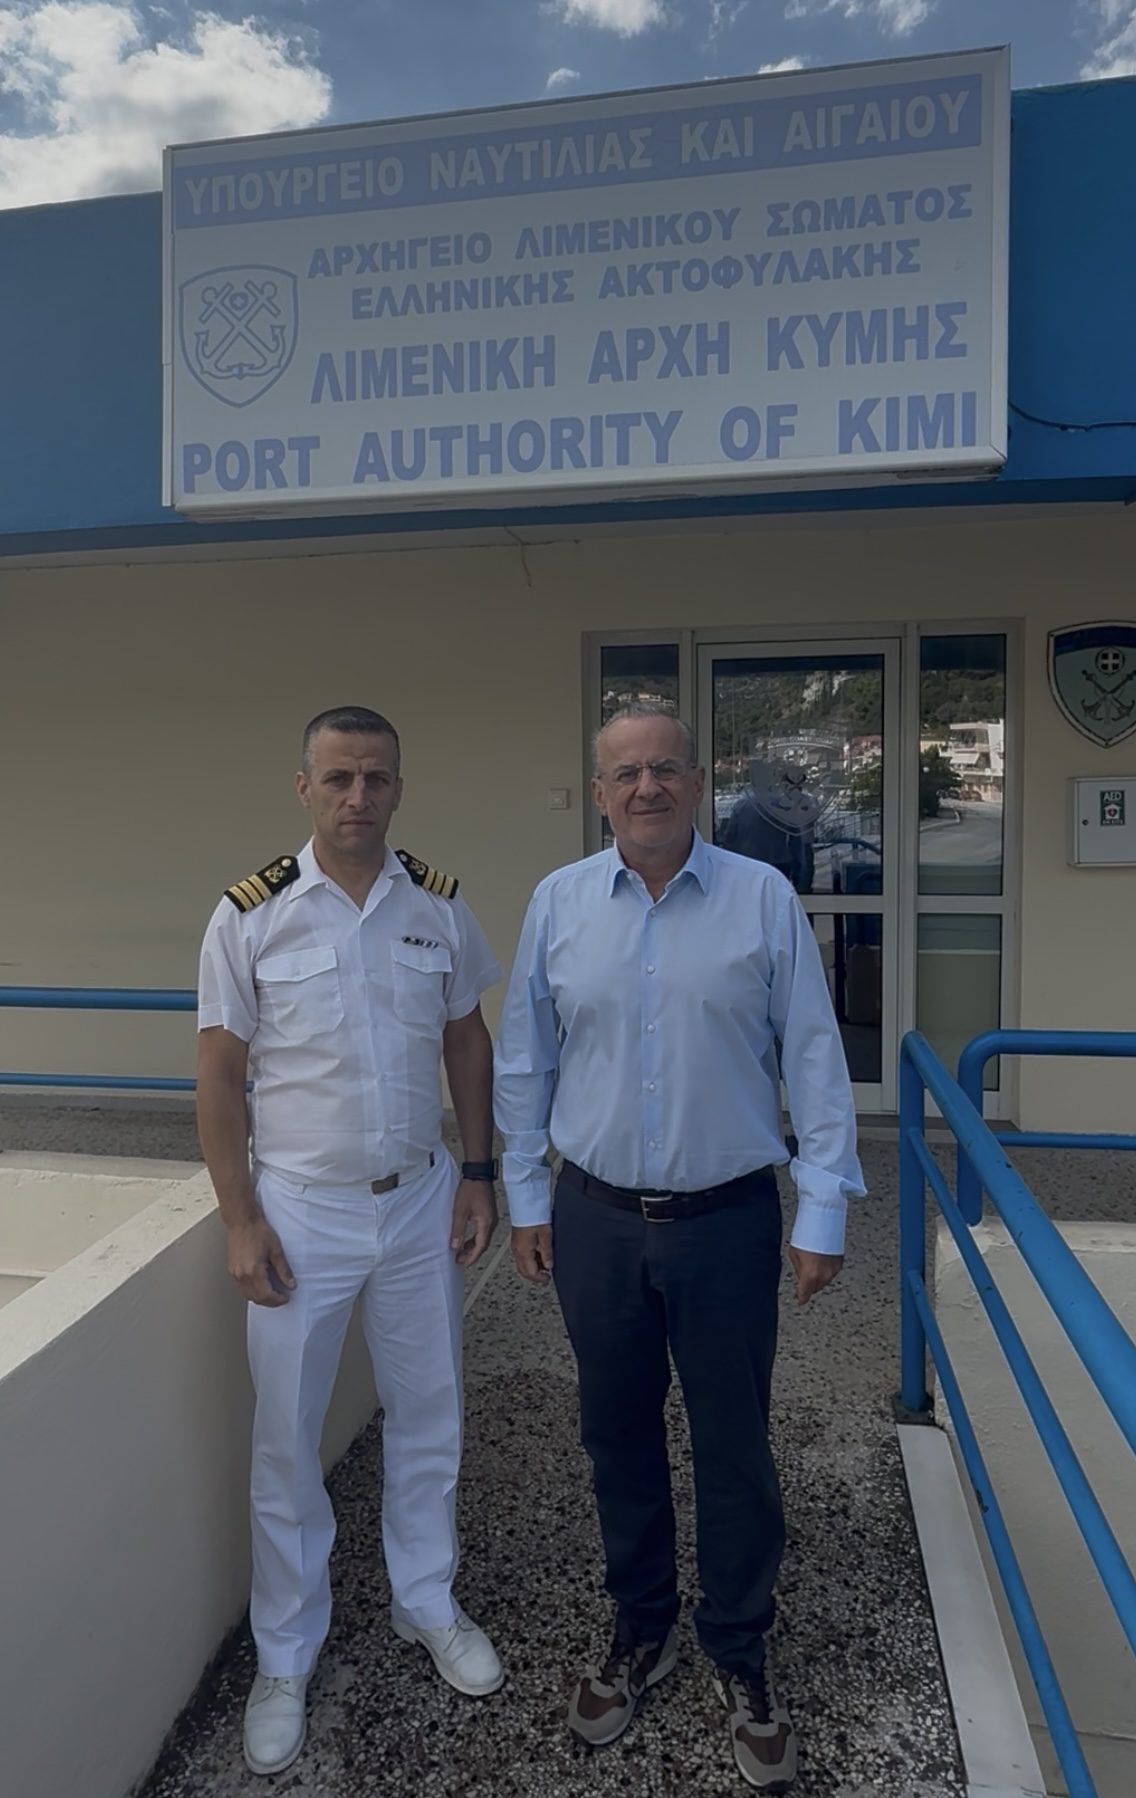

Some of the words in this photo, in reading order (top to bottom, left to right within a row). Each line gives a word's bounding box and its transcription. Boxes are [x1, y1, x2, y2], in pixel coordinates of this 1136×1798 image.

[186, 156, 404, 214] ΥΠΟΥΡΓΕΙΟ
[431, 128, 653, 190] ΝΑΥΤΙΛΙΑΣ
[681, 116, 754, 164] ΚΑΙ
[784, 90, 969, 153] ΑΙΓΑΙΟΥ
[308, 231, 492, 278] ΑΡΧΗΓΕΙΟ
[515, 208, 741, 259] ΛΙΜΕΝΙΚΟΥ
[767, 184, 972, 237] ΣΩΜΑΤΟΣ
[352, 270, 575, 320] ΕΛΛΗΝΙΚΗΣ
[599, 239, 920, 299] ΑΚΤΟΦΥΛΑΚΗΣ
[311, 335, 555, 403] ΛΙΜΕΝΙΚΗ
[588, 321, 730, 384] ΑΡΧΗ
[767, 302, 968, 371] ΚΥΜΗΣ
[183, 435, 321, 493] PORT
[353, 410, 683, 484] AUTHORITY
[720, 404, 798, 461] OF
[838, 391, 977, 455] KIMI
[1104, 792, 1122, 801] AED
